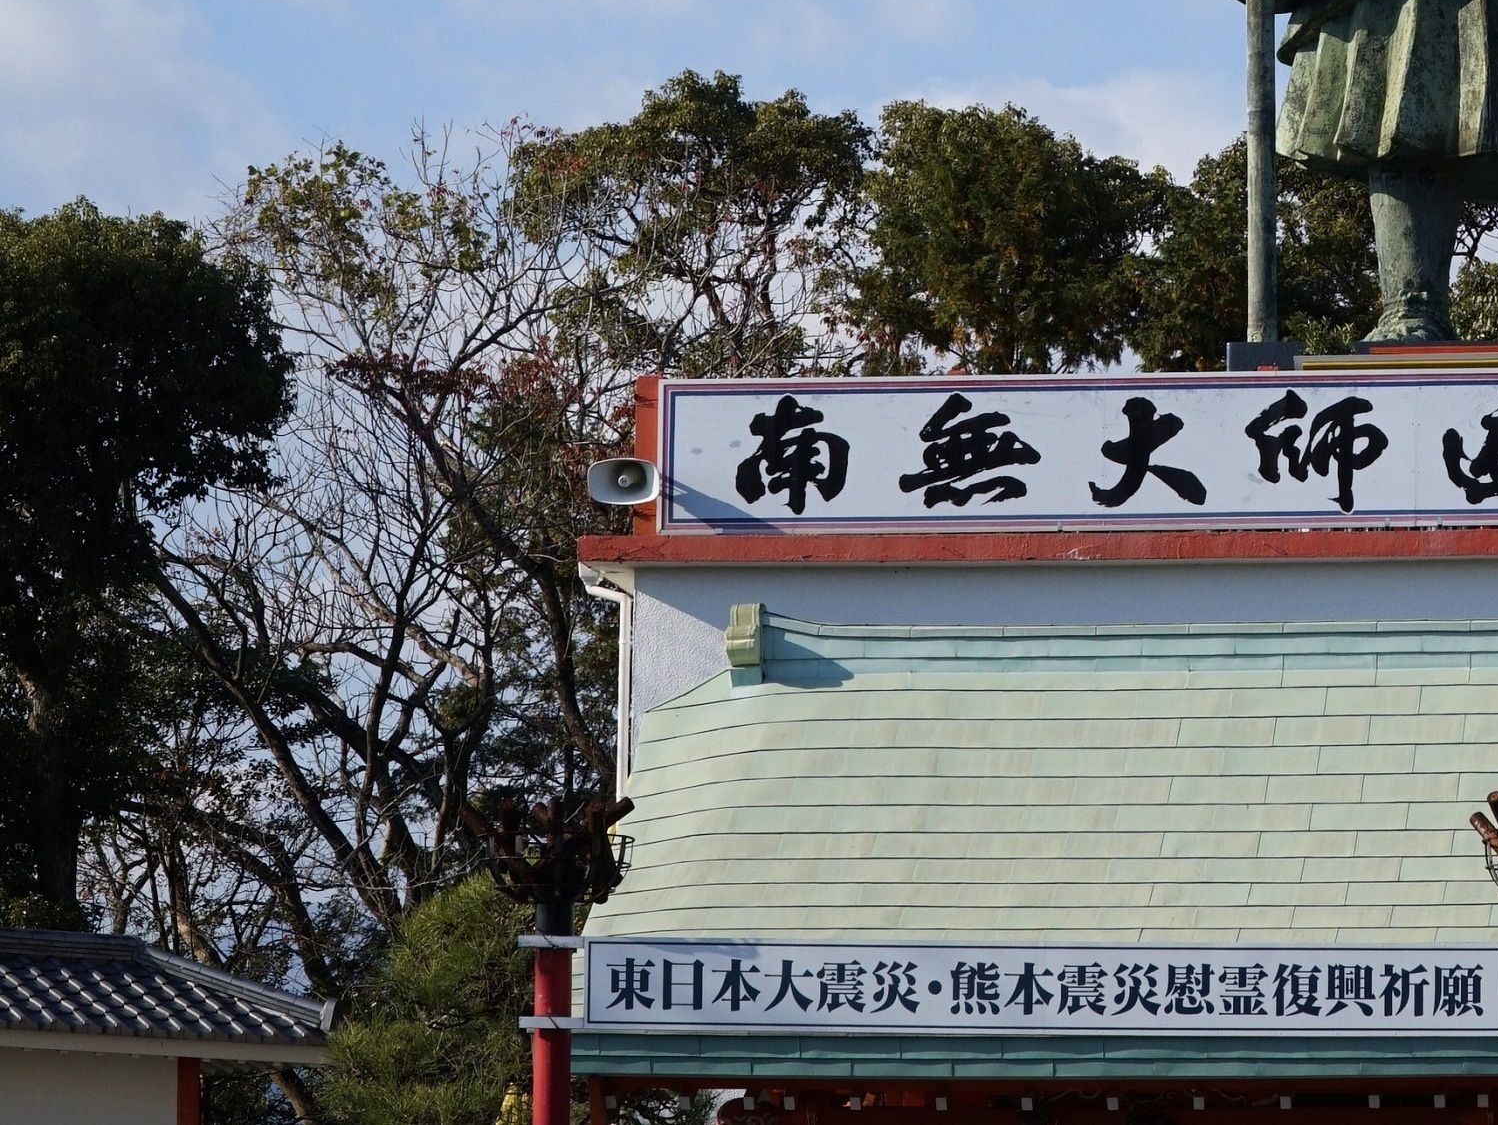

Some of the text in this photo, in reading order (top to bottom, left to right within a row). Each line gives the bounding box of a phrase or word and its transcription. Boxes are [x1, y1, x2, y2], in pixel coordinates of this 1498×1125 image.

[605, 957, 1484, 1017] 東日本大震災・熊本震災慰霊復興祈願
